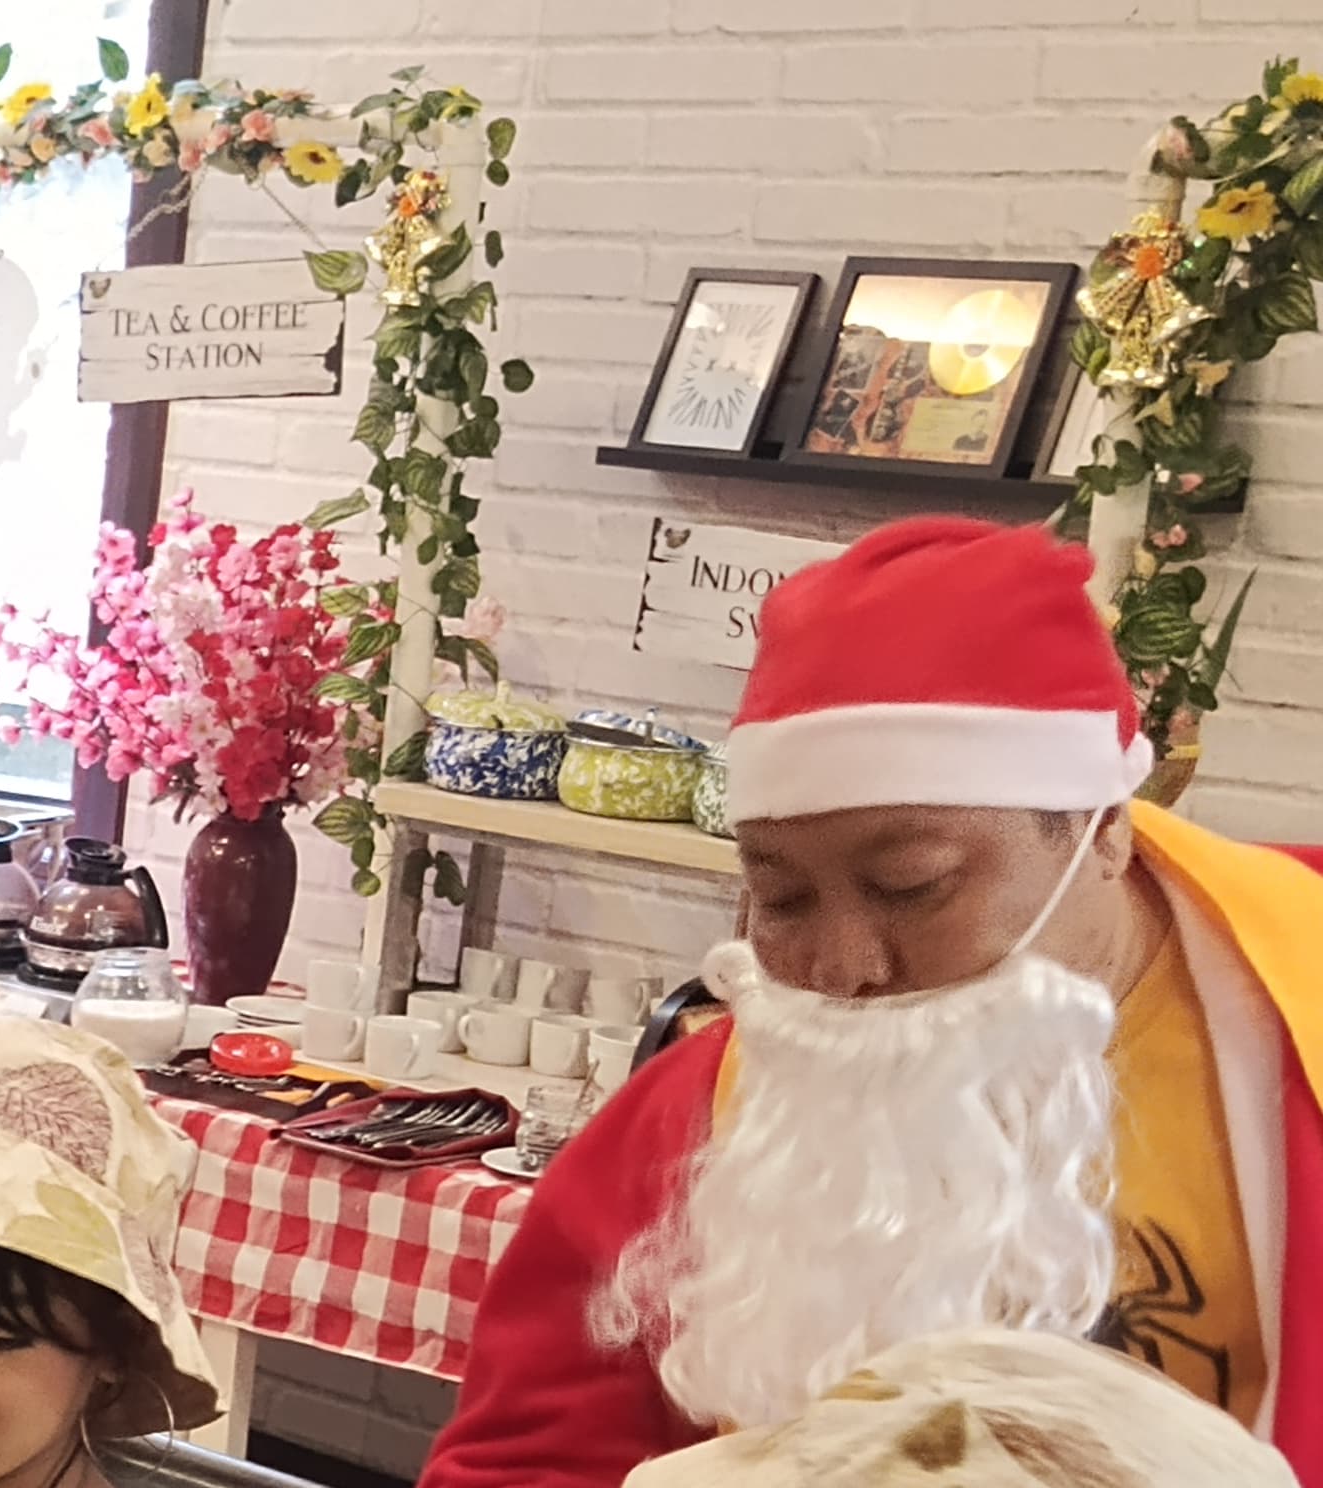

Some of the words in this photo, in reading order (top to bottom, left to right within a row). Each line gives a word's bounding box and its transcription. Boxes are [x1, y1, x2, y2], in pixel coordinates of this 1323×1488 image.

[109, 307, 160, 337] TEA
[170, 304, 191, 333] &
[201, 302, 308, 331] COFFEE
[146, 342, 263, 371] STATION
[691, 555, 785, 597] INDO
